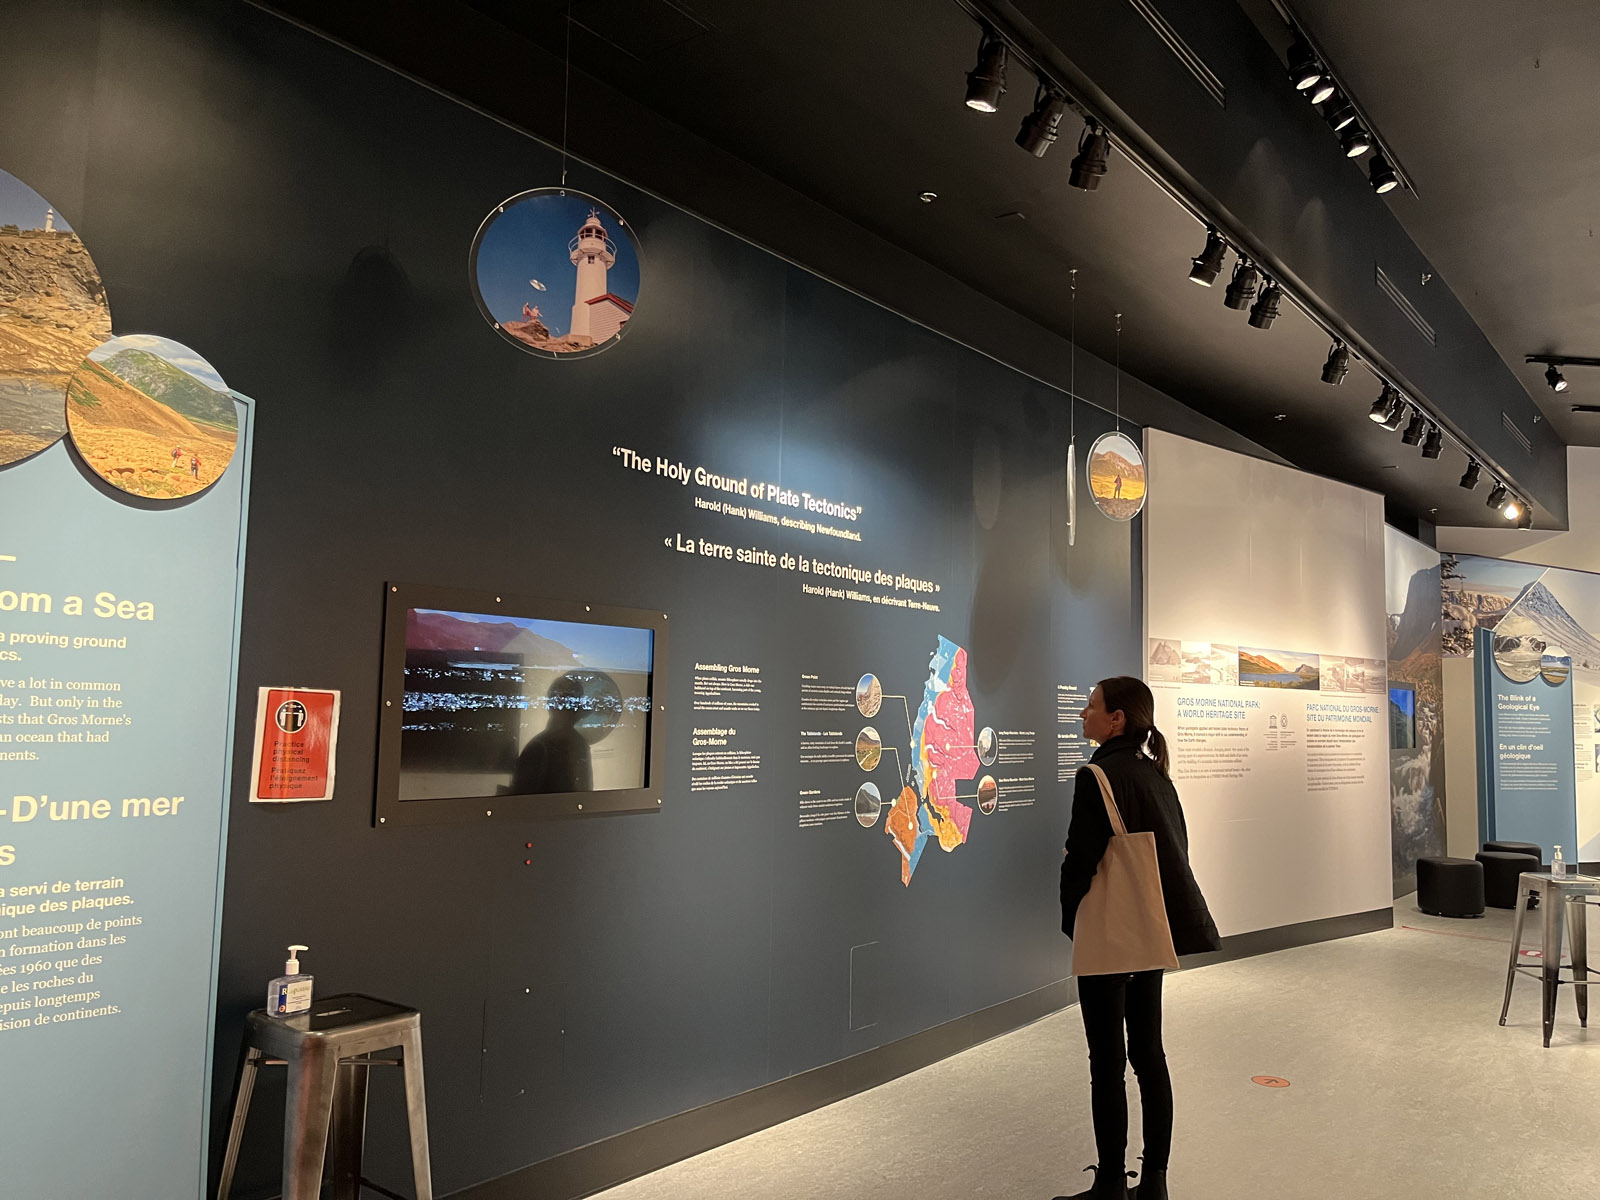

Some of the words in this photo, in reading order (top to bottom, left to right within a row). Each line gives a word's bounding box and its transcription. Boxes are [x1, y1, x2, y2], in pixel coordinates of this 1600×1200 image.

[612, 446, 652, 473] “The
[656, 456, 692, 486] Holy
[694, 466, 747, 496] Ground
[750, 482, 765, 500] of
[768, 484, 800, 508] Plate
[802, 492, 862, 522] Tectonics”
[694, 496, 721, 512] Harold
[722, 502, 746, 519] (Hank)
[748, 509, 780, 526] Williams,
[780, 516, 816, 534] describing
[816, 524, 862, 541] Newfoundland.
[676, 533, 694, 554] La
[699, 538, 733, 560] terre
[736, 546, 777, 567] sainte
[780, 552, 796, 570] de
[798, 555, 810, 572] la
[812, 558, 872, 584] tectonique
[874, 569, 893, 586] des
[896, 574, 934, 594] plaques
[62, 596, 83, 616] a
[94, 592, 155, 620] Sea
[802, 584, 824, 596] Harold
[825, 587, 845, 600] (Hank)
[881, 595, 906, 608] décrivant
[10, 632, 69, 649] proving
[73, 636, 127, 649] ground
[694, 662, 728, 674] Assembling
[728, 664, 742, 672] Gros
[742, 666, 760, 674] Morne
[18, 680, 26, 690] a
[30, 677, 48, 690] lot
[50, 678, 63, 690] in
[66, 681, 121, 692] common
[0, 694, 22, 710] ay.
[30, 696, 53, 708] But
[56, 696, 84, 710] only
[87, 696, 100, 708] in
[102, 696, 123, 708] the
[1177, 697, 1194, 706] GROS
[1196, 698, 1216, 707] MORNE
[1218, 699, 1244, 708] NATIONAL
[1498, 703, 1528, 711] Geological
[18, 712, 44, 726] that
[47, 714, 78, 726] Gros
[81, 714, 132, 726] Morne’s
[1177, 709, 1182, 718] A
[1183, 709, 1204, 718] WORLD
[1206, 710, 1232, 718] HERITAGE
[1234, 711, 1246, 719] SITE
[16, 734, 54, 744] ocean
[58, 731, 83, 744] that
[86, 731, 110, 744] had
[692, 728, 728, 736] Assemblage
[728, 728, 736, 736] du
[692, 738, 728, 746] Gros-Morne
[1500, 752, 1531, 760] géologique
[122, 796, 185, 818] mer
[10, 882, 48, 897] servi
[52, 880, 71, 894] de
[75, 876, 124, 892] terrain
[0, 903, 36, 918] ique
[40, 898, 68, 914] des
[72, 894, 135, 912] plaques.
[22, 919, 84, 938] beaucoup
[86, 918, 102, 931] de
[104, 914, 143, 932] points
[10, 940, 74, 957] formation
[77, 936, 107, 950] dans
[110, 934, 127, 946] les
[20, 959, 52, 976] 1960
[55, 958, 78, 972] que
[82, 954, 103, 966] des
[12, 980, 30, 994] les
[33, 975, 74, 990] roches
[78, 972, 94, 985] du
[34, 990, 101, 1010] longtemps
[34, 1012, 50, 1026] de
[53, 1004, 122, 1024] continents.
